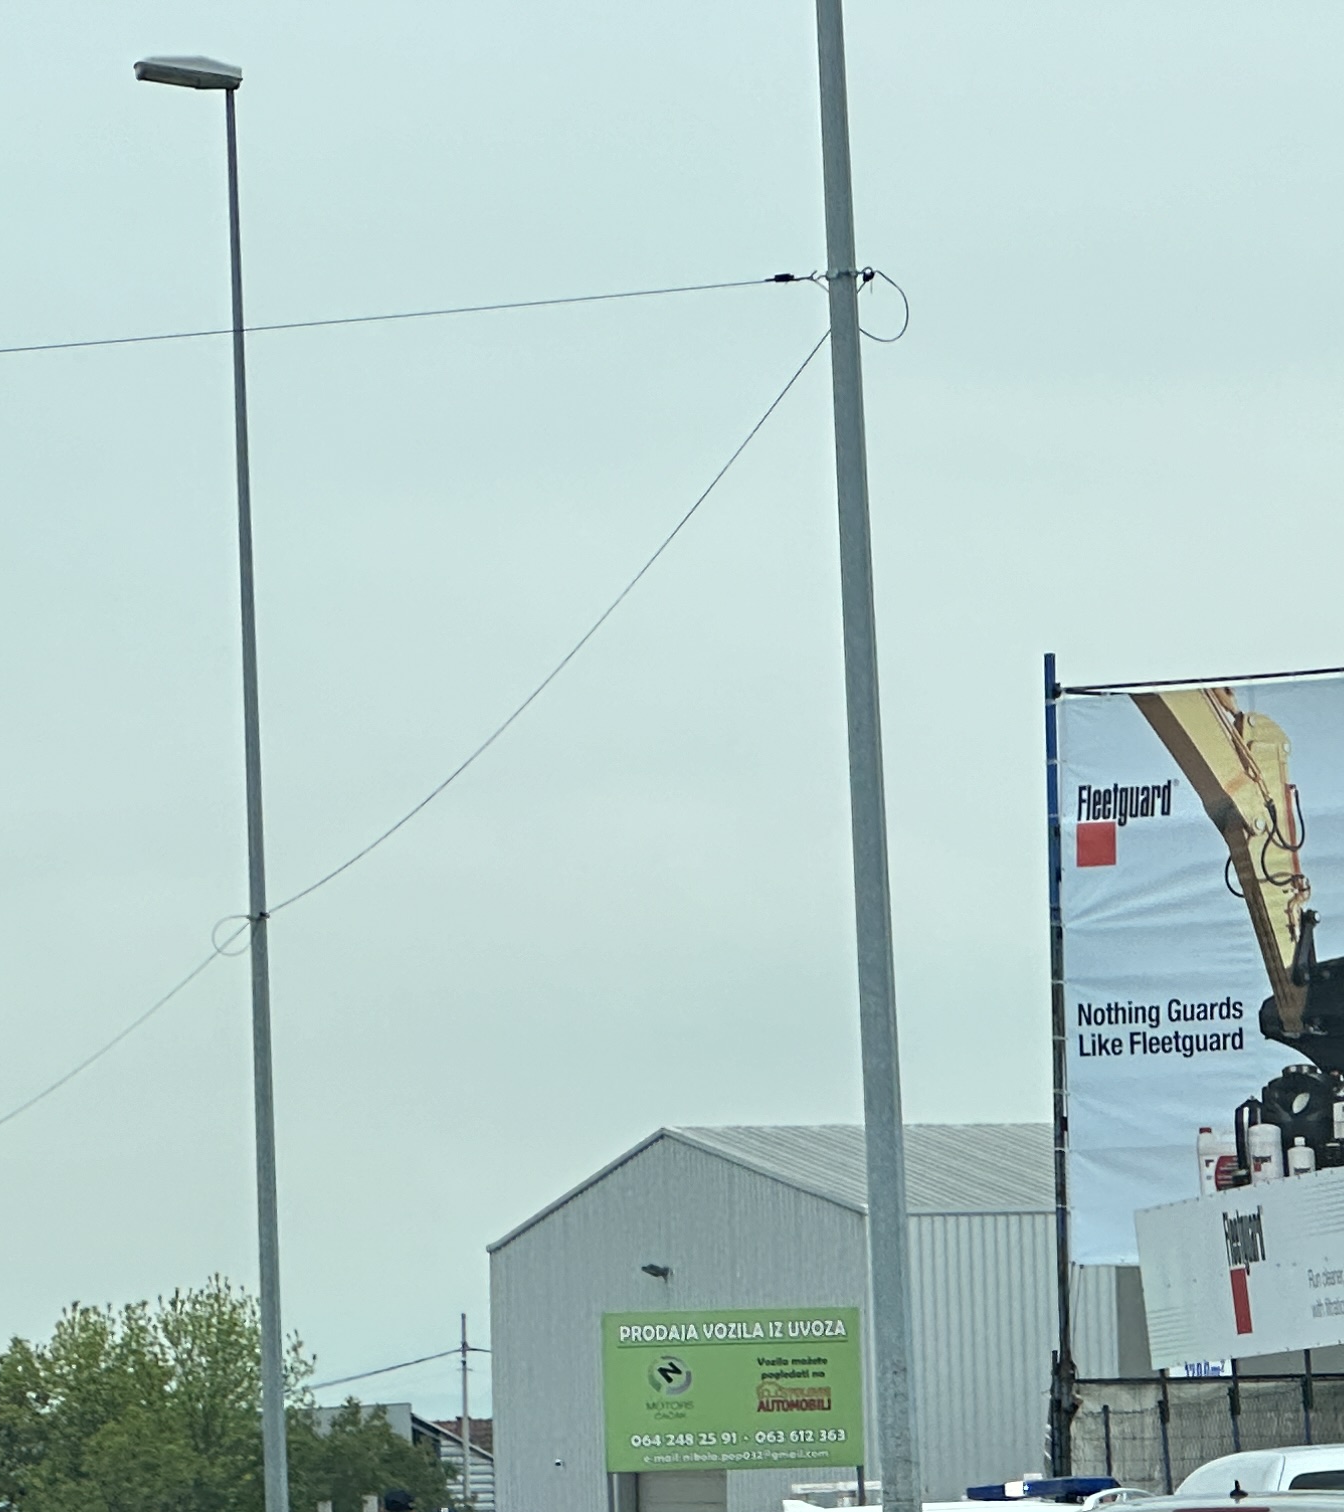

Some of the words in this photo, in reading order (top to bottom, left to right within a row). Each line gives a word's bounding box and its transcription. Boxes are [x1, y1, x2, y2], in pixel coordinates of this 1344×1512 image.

[1077, 779, 1173, 827] Fleetguard
[1078, 1001, 1161, 1028] Nothing
[1167, 996, 1244, 1023] Guards
[1078, 1033, 1124, 1057] Like
[1129, 1027, 1244, 1058] Fleetguard
[619, 1323, 699, 1343] PRODAJA
[702, 1322, 764, 1340] VOZILA
[768, 1321, 784, 1338] IZ
[787, 1319, 846, 1338] UVOZA
[757, 1398, 831, 1413] AUTOMOBILI
[631, 1434, 662, 1448] 064
[666, 1433, 694, 1447] 248
[699, 1433, 717, 1445] 25
[721, 1431, 737, 1445] 91
[755, 1430, 785, 1444] 063
[789, 1430, 814, 1443] 612
[818, 1428, 845, 1442] 363
